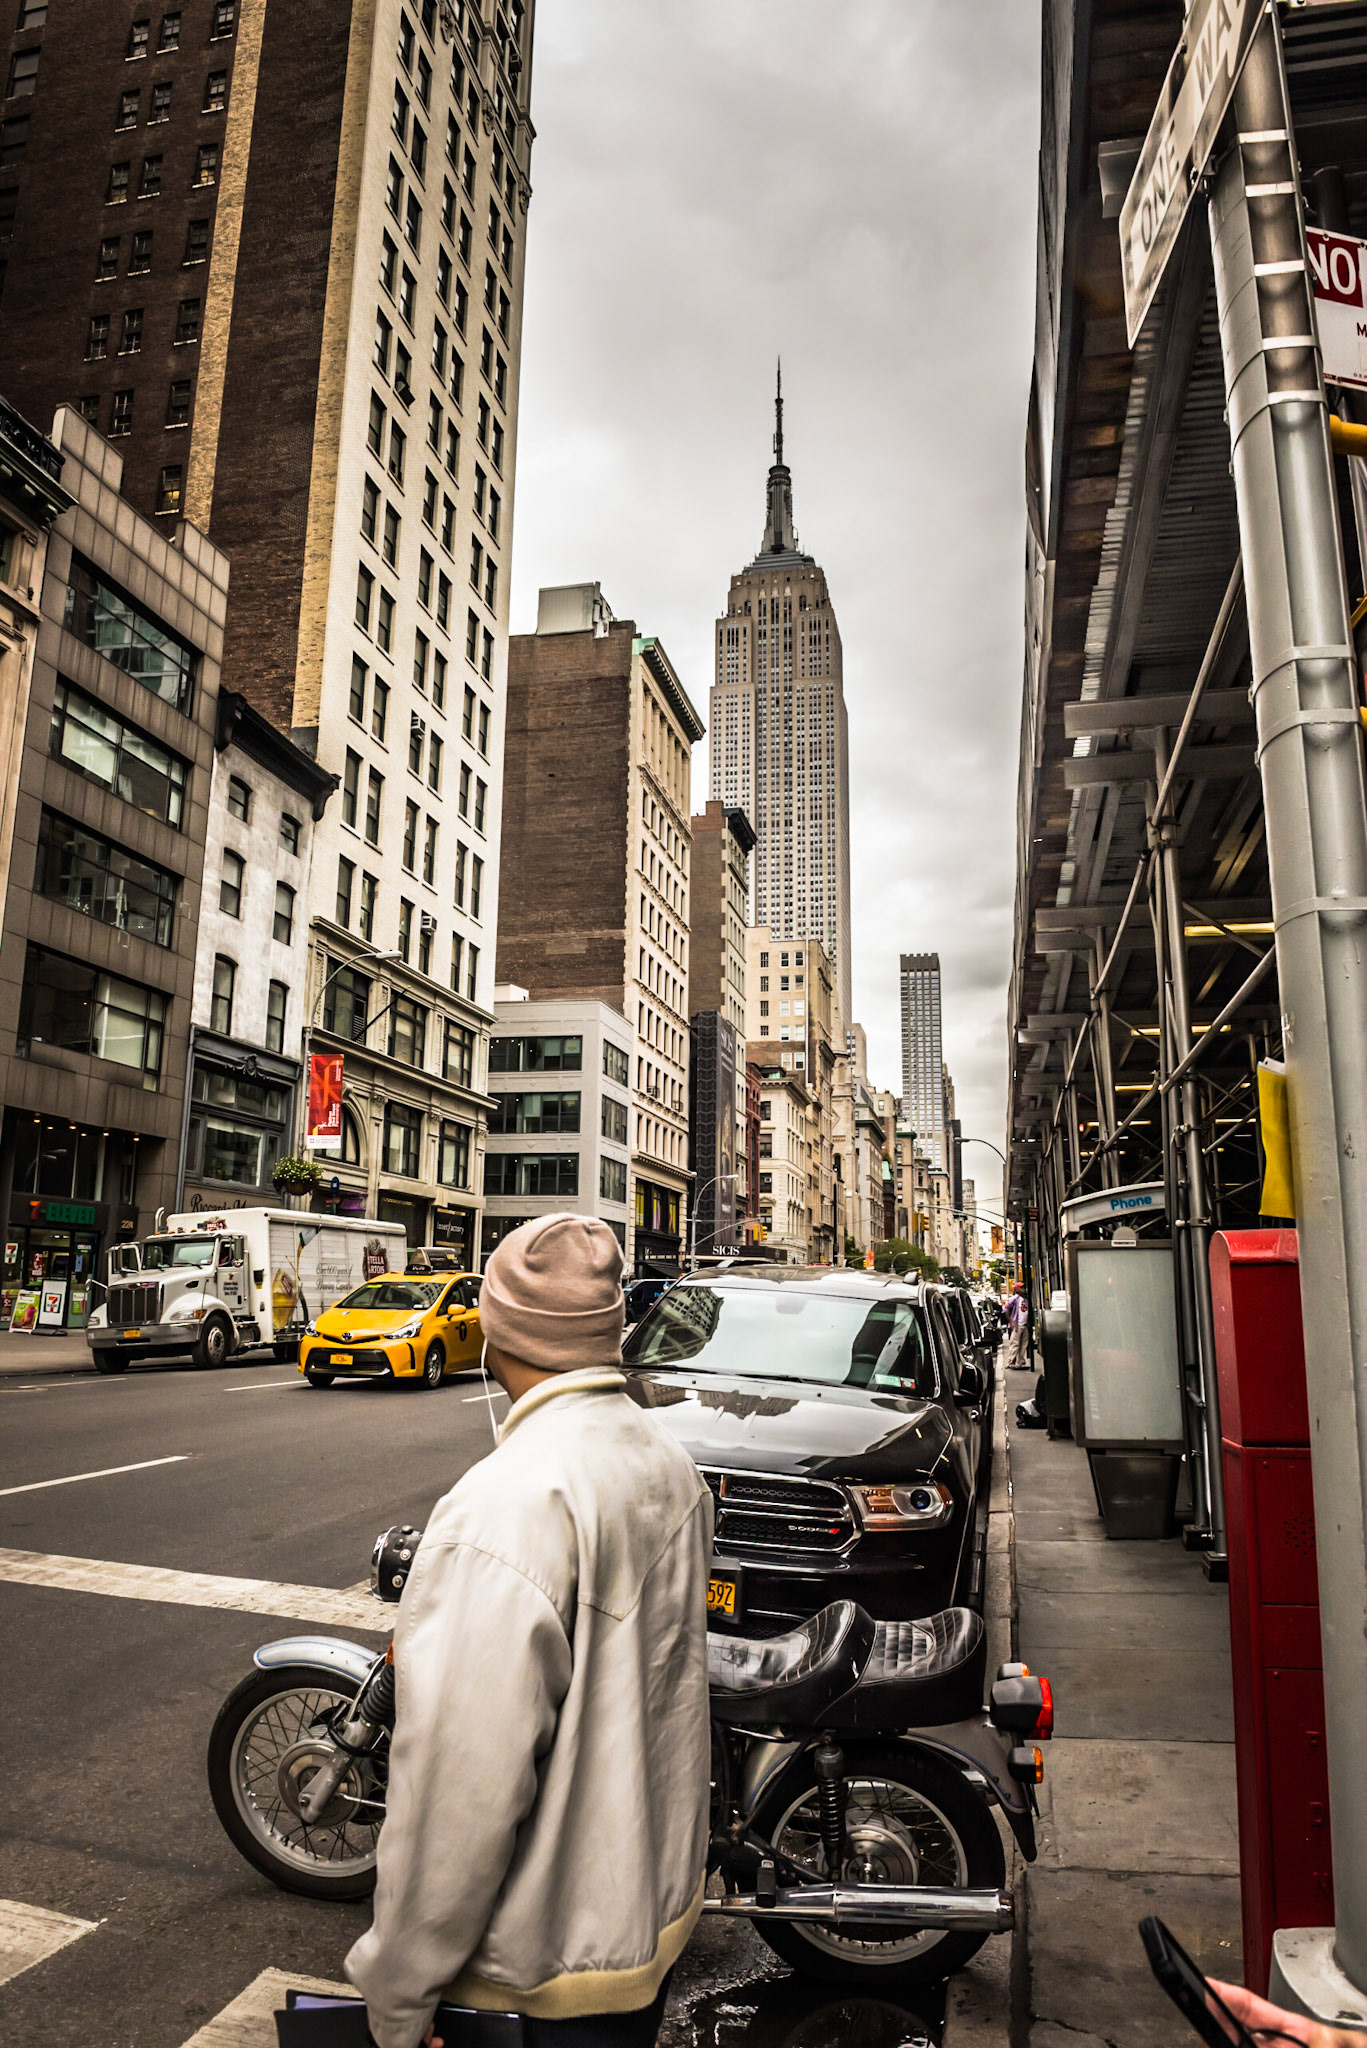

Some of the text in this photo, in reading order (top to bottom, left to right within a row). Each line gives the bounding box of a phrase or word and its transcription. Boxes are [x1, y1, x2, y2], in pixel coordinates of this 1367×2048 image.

[1142, 119, 1180, 252] ONE
[1306, 242, 1357, 296] NO
[1110, 1196, 1152, 1210] Phone
[712, 1245, 740, 1256] SICIS
